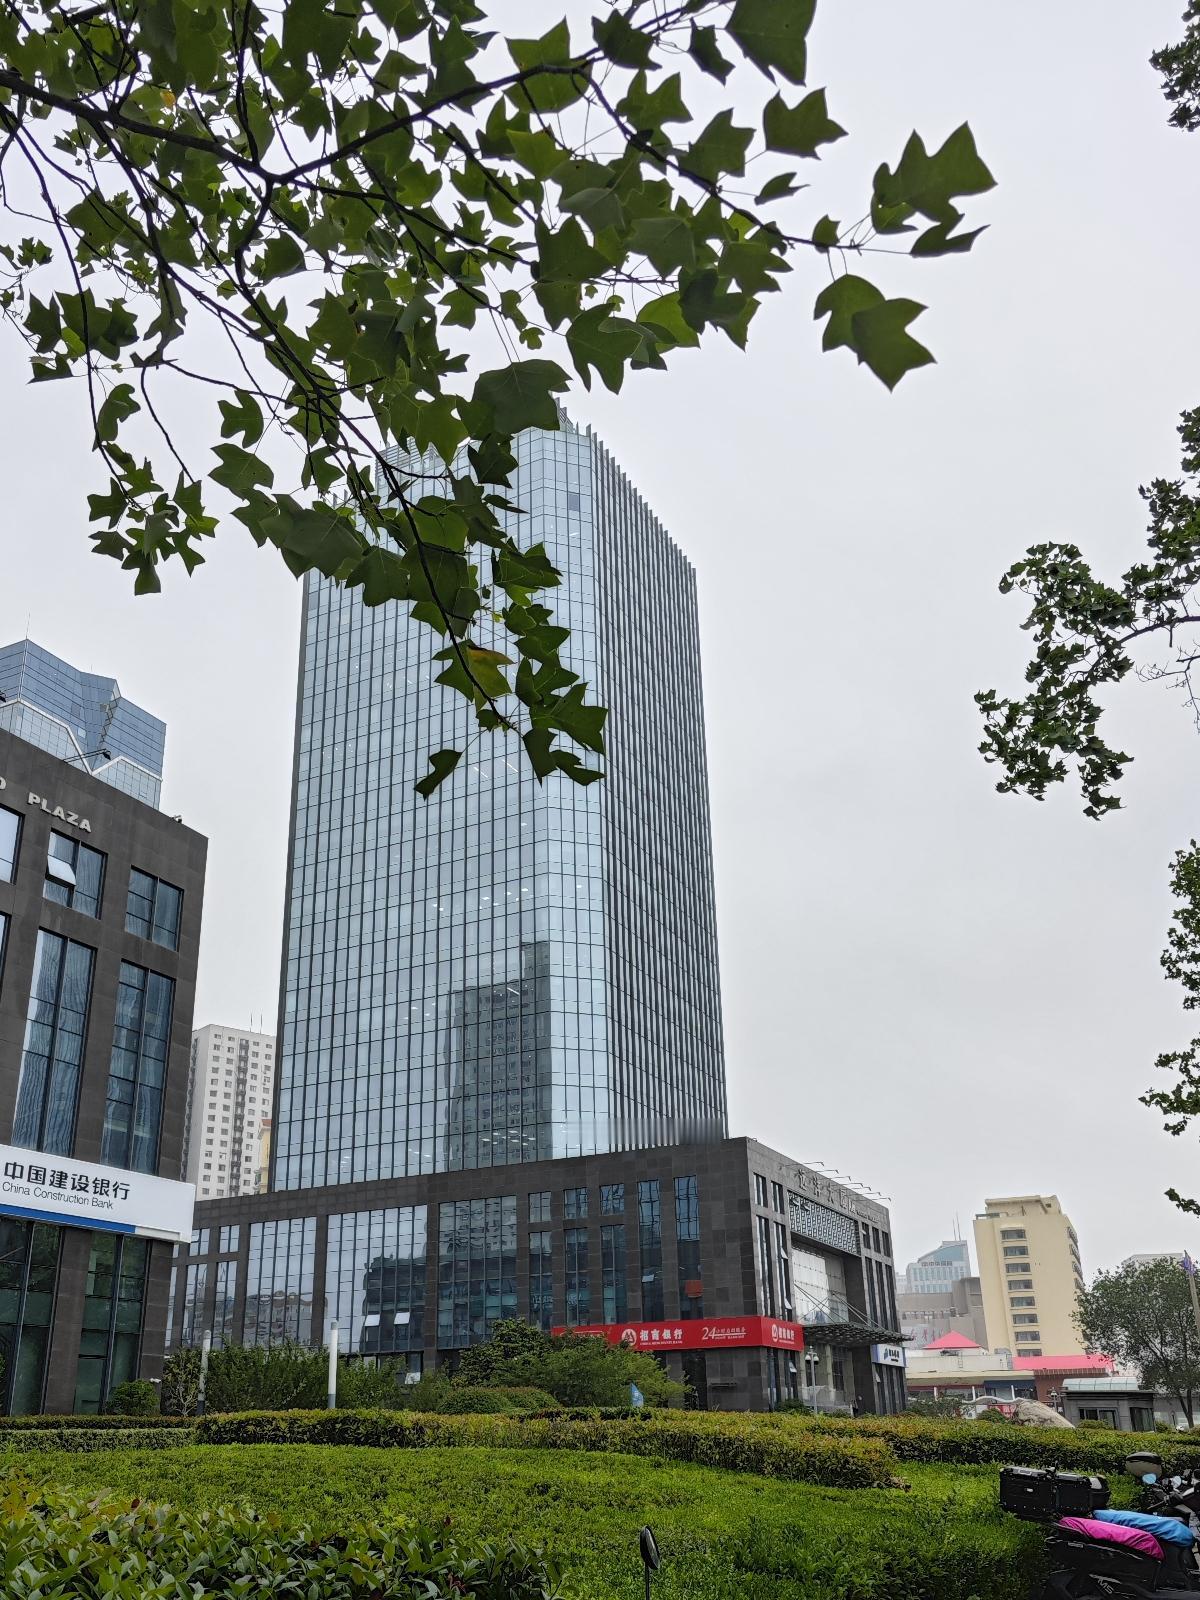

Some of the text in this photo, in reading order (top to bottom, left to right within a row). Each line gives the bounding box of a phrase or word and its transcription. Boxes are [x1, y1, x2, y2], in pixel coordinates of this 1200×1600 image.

[27, 791, 92, 833] PLAZA
[2, 1181, 114, 1210] China Construction Bank
[4, 1161, 131, 1201] 中国建设银行
[639, 1328, 683, 1342] 招商银行
